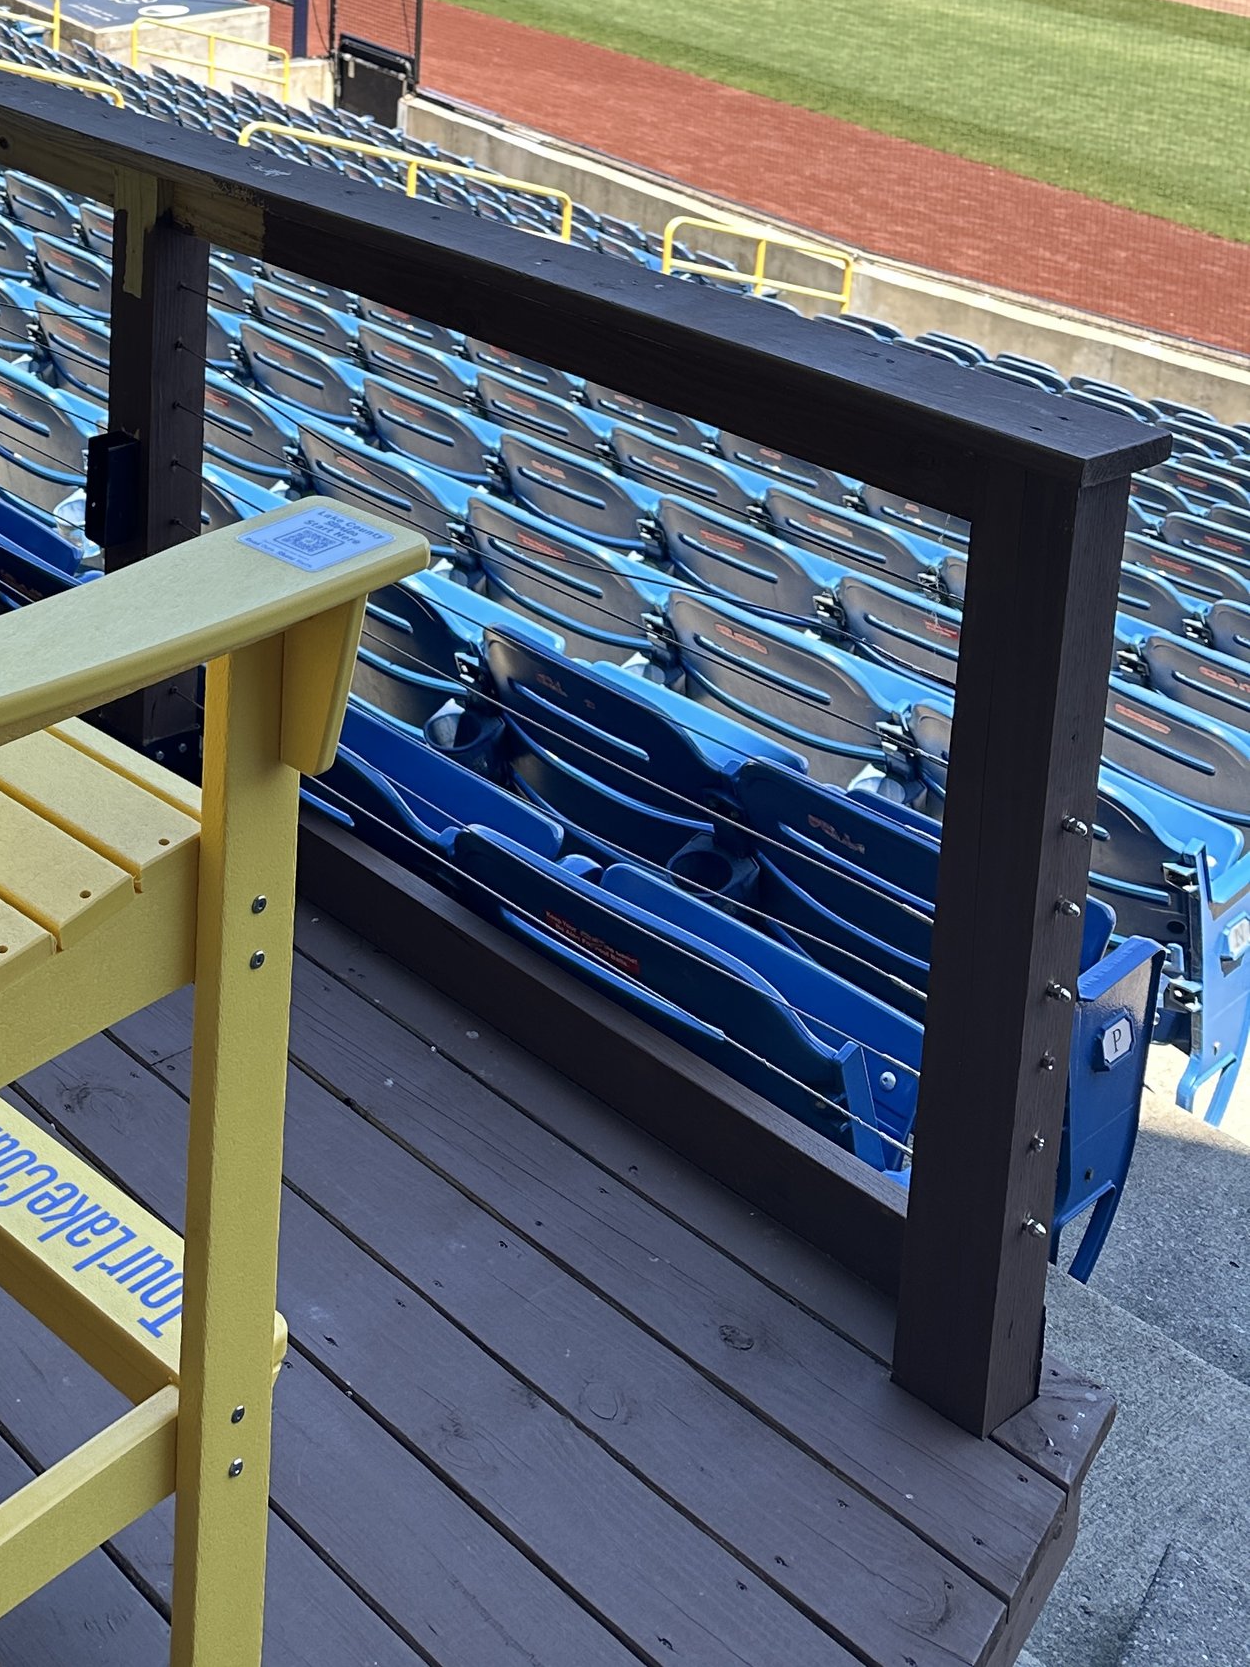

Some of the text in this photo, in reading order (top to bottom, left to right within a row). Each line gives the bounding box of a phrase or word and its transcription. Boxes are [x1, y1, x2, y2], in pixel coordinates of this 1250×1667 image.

[303, 518, 361, 546] Start Here
[317, 509, 385, 541] Lake County
[1112, 1027, 1122, 1055] P
